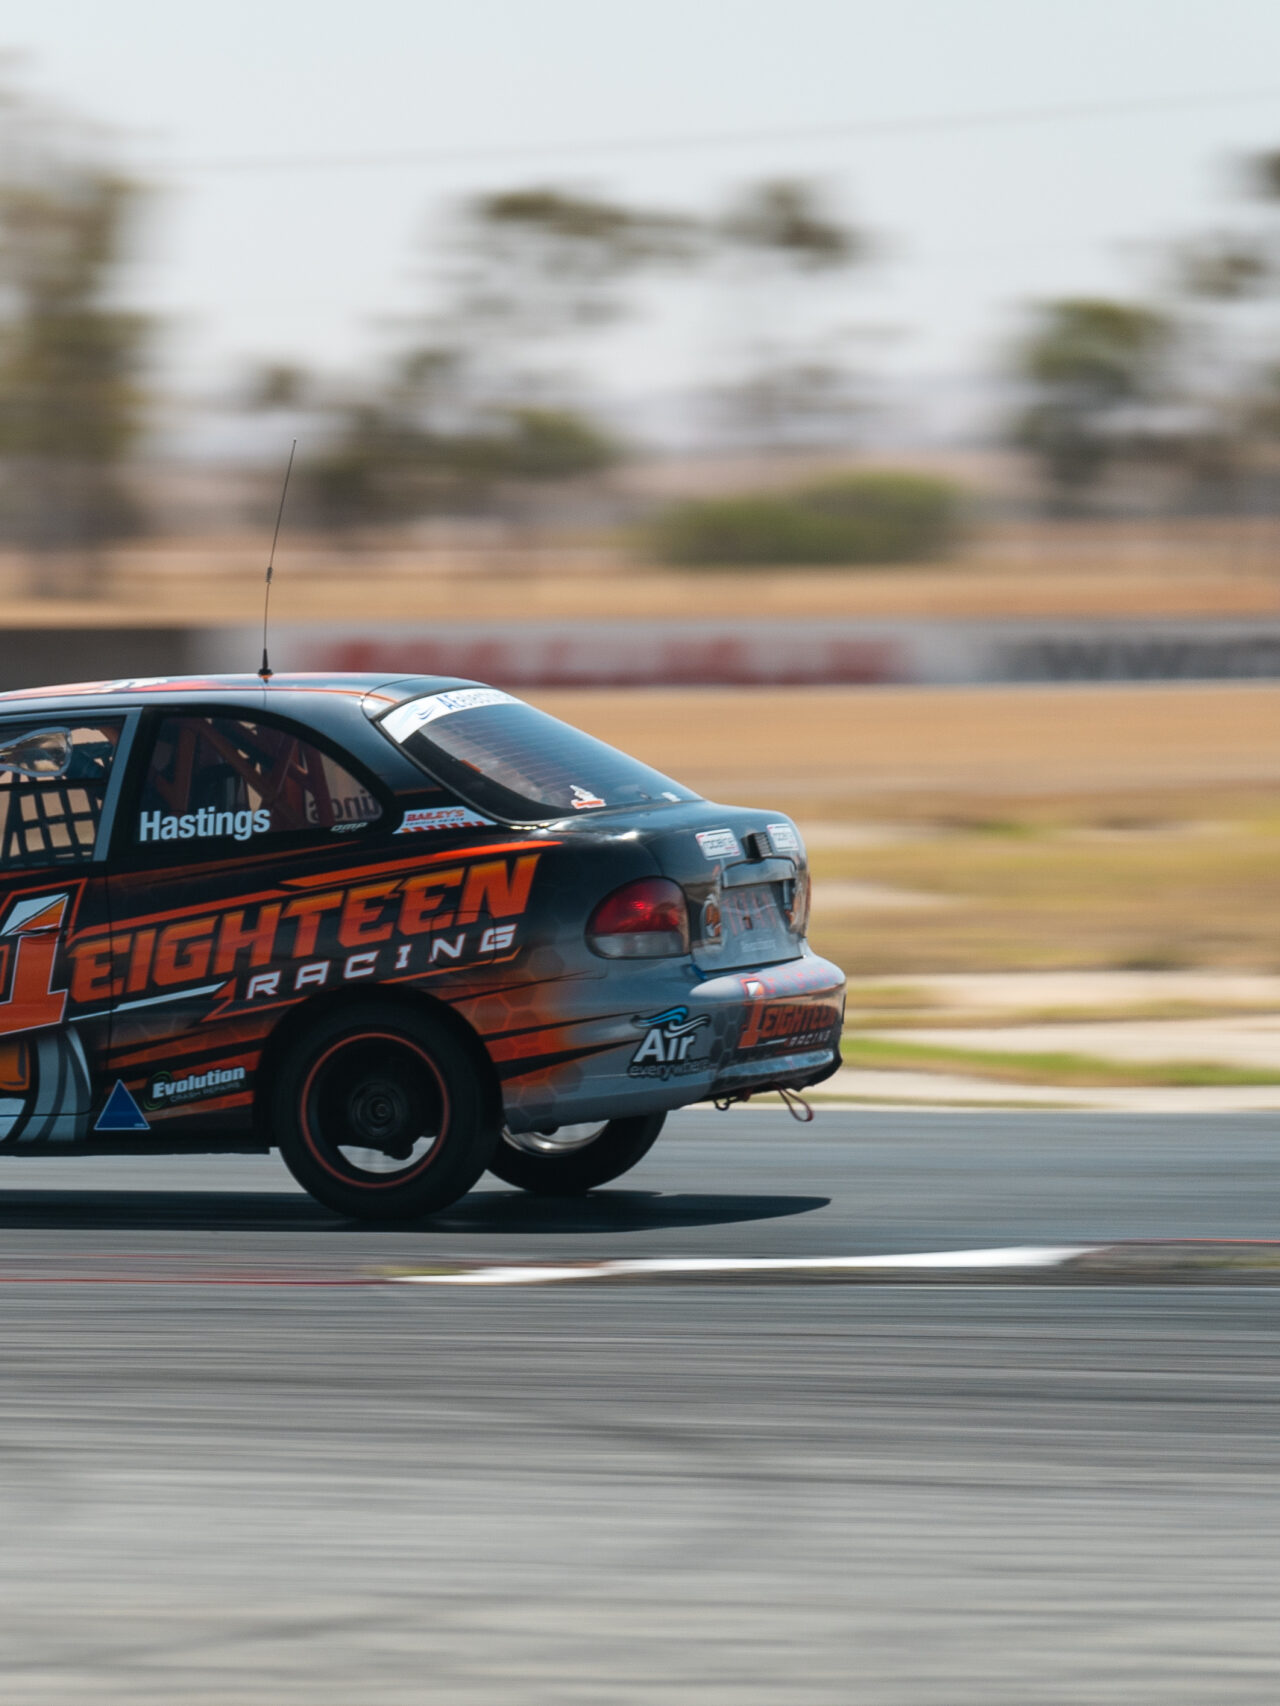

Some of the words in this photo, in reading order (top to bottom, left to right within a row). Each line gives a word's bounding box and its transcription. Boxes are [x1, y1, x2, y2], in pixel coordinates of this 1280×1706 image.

[140, 806, 271, 841] Hastings
[246, 923, 518, 1000] RACING
[633, 1027, 697, 1062] Air
[152, 1067, 246, 1098] Evolution
